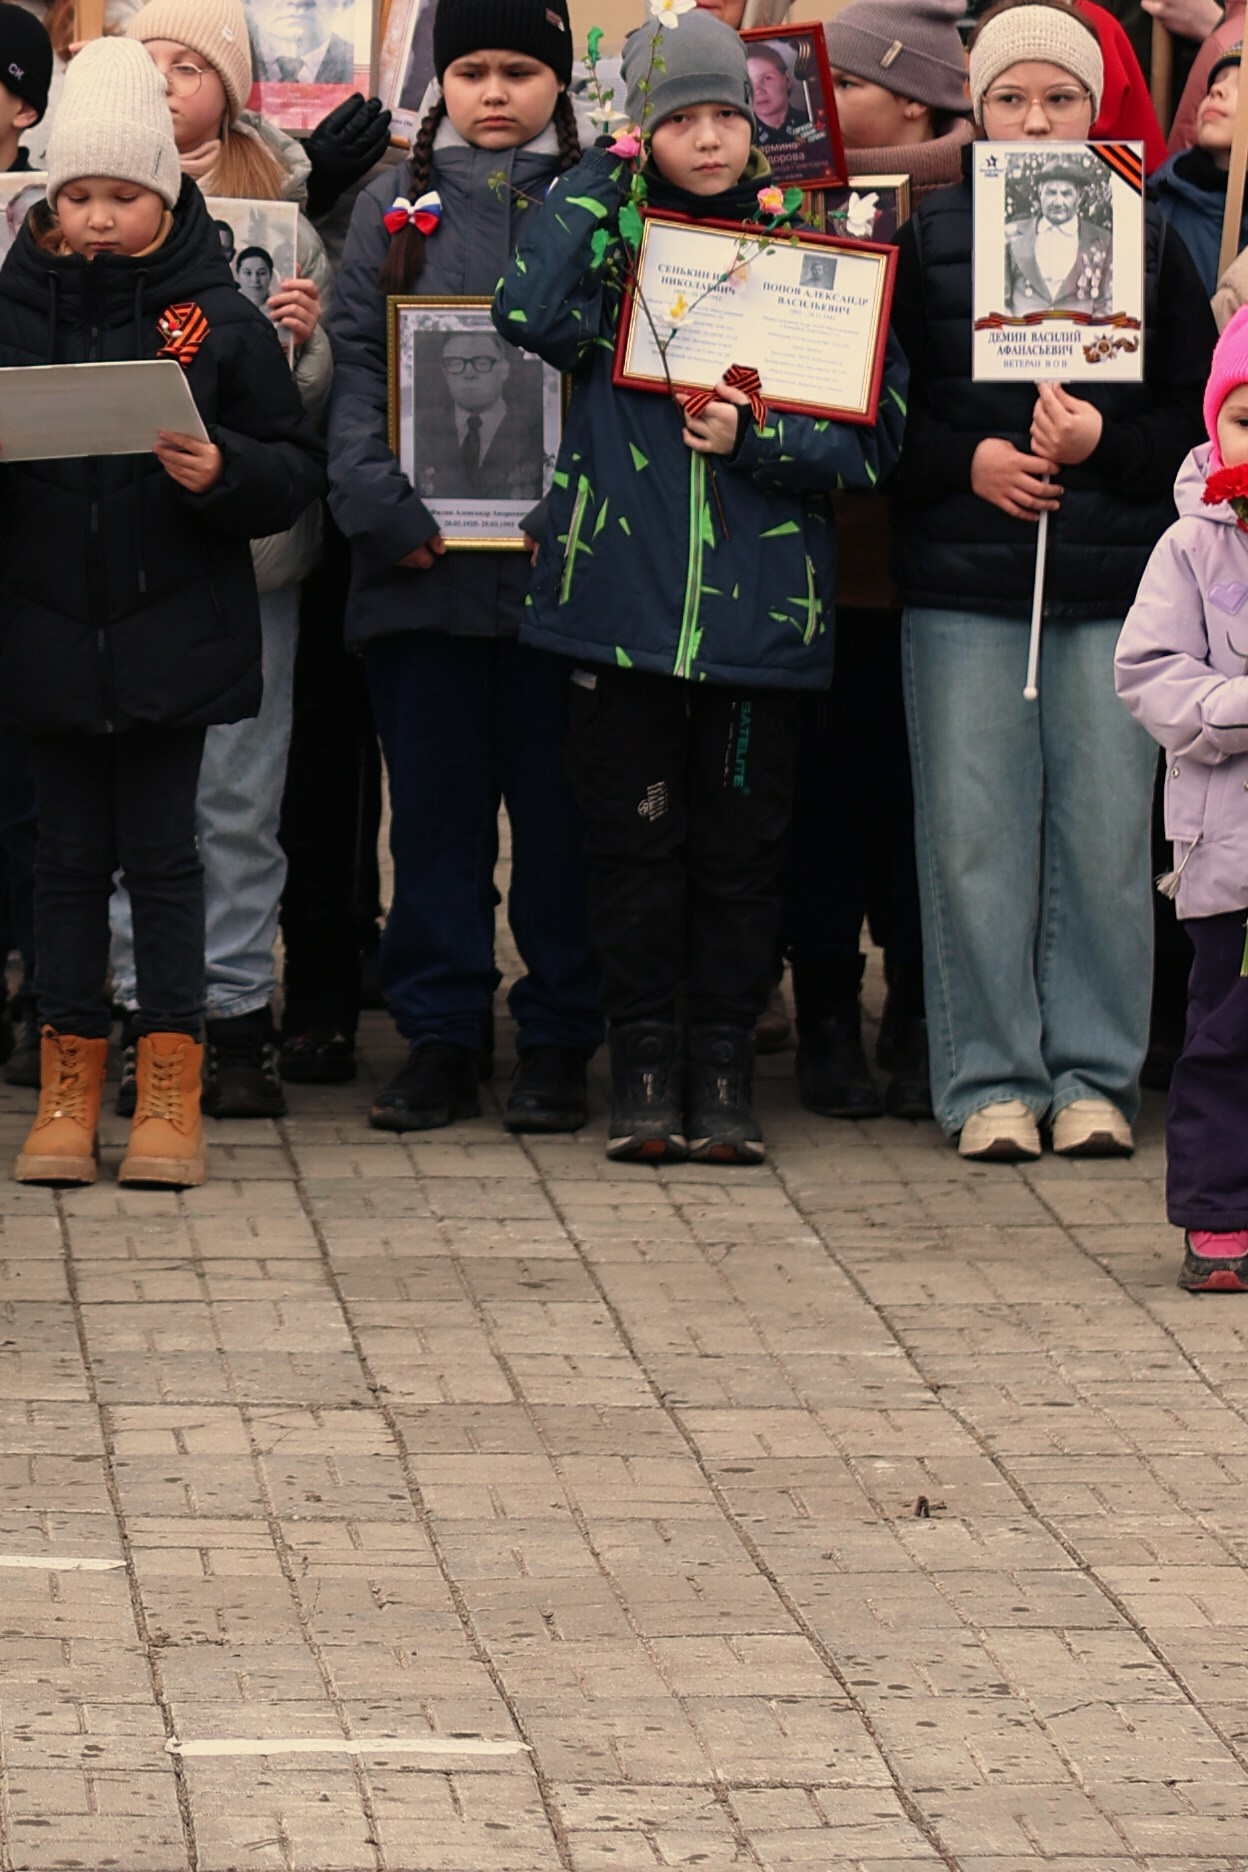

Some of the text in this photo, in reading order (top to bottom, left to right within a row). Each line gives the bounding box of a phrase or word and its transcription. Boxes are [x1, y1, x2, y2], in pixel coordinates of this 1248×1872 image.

[658, 263, 710, 279] СЕНЬКИН
[763, 281, 869, 306] ПОПОВ АЛЕКСАНДР
[777, 296, 850, 315] ВАСИЛЬЕВИЧ
[988, 329, 1081, 344] ДЕМИН ВАСИЛИЙ
[997, 345, 1073, 356] АФАНАСЬЕВИЧ
[1003, 359, 1041, 368] ВЕТЕРАН
